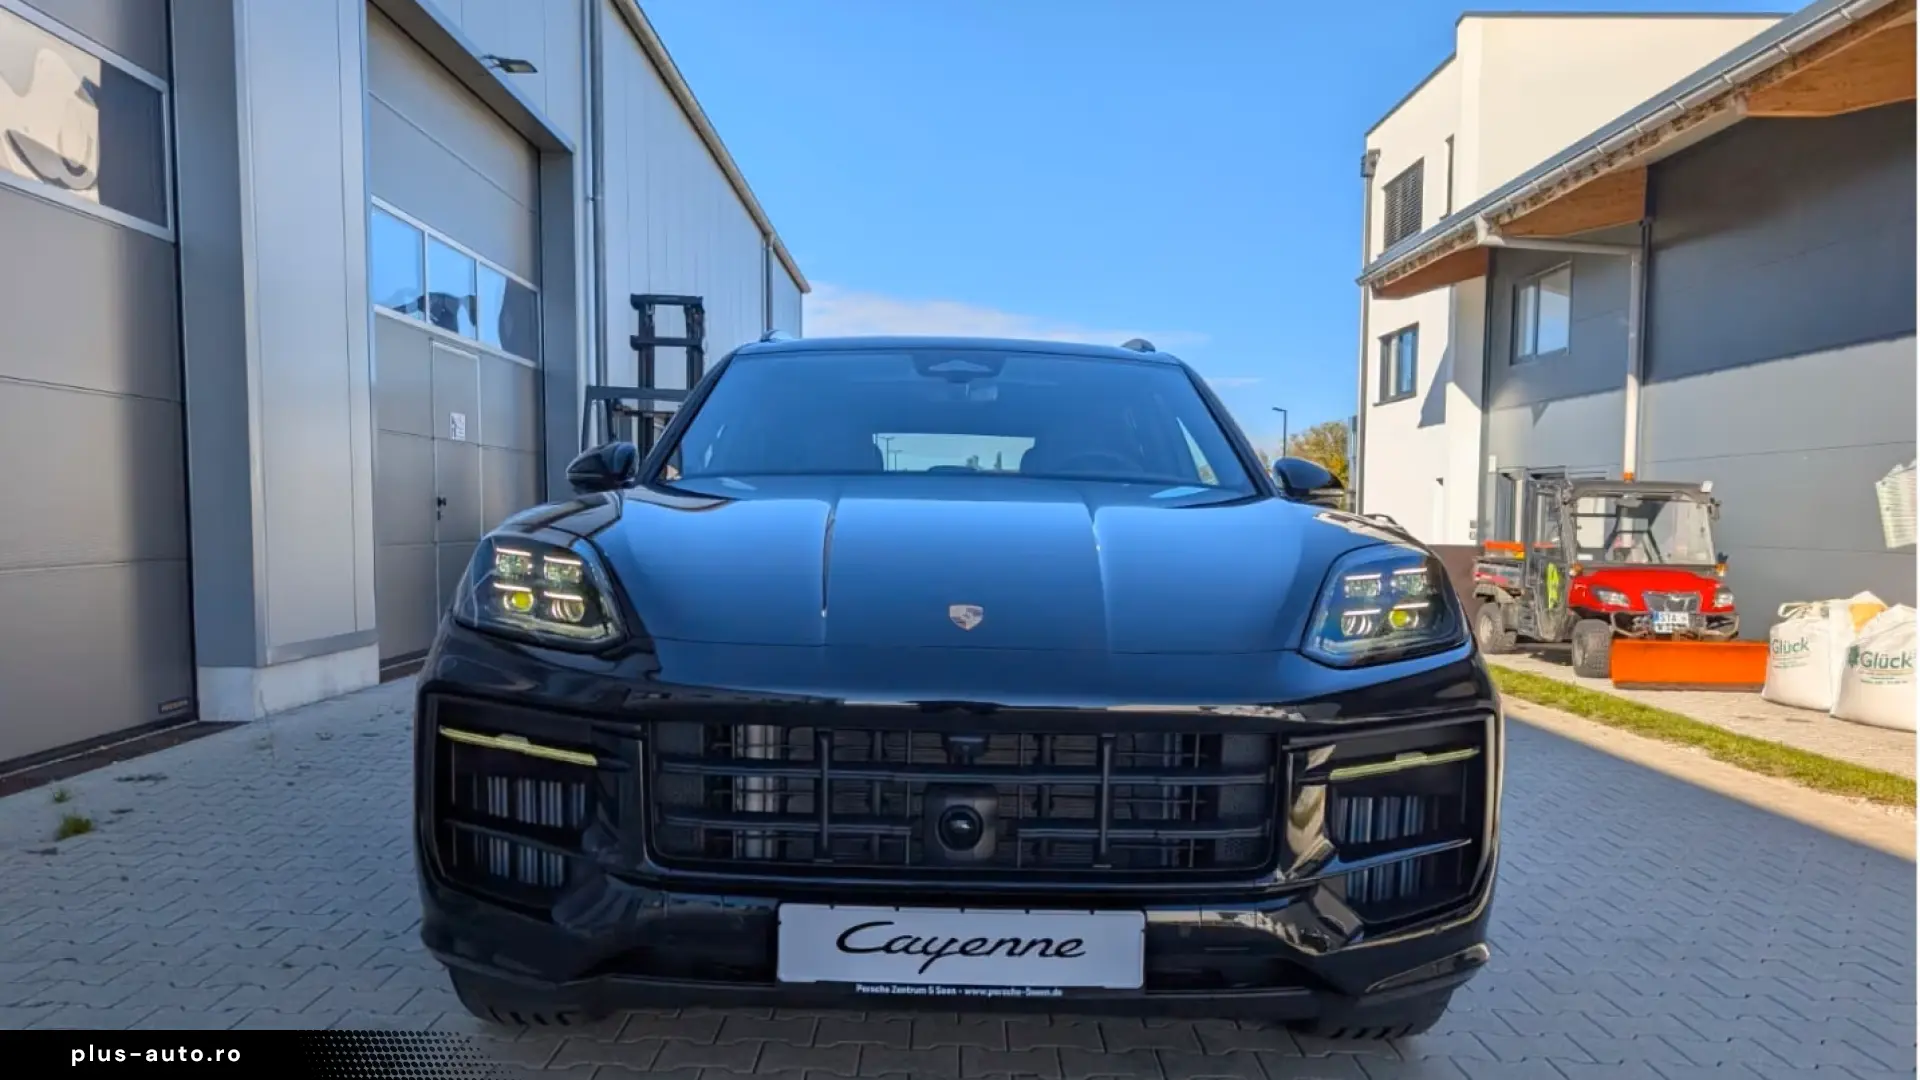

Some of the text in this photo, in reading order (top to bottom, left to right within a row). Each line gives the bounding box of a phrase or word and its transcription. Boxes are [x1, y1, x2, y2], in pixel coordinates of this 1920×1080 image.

[1772, 636, 1810, 654] Glück
[1860, 650, 1914, 669] Glück
[836, 921, 1085, 974] Cayenne
[856, 983, 890, 994] Porsche
[891, 984, 926, 995] Zentrum
